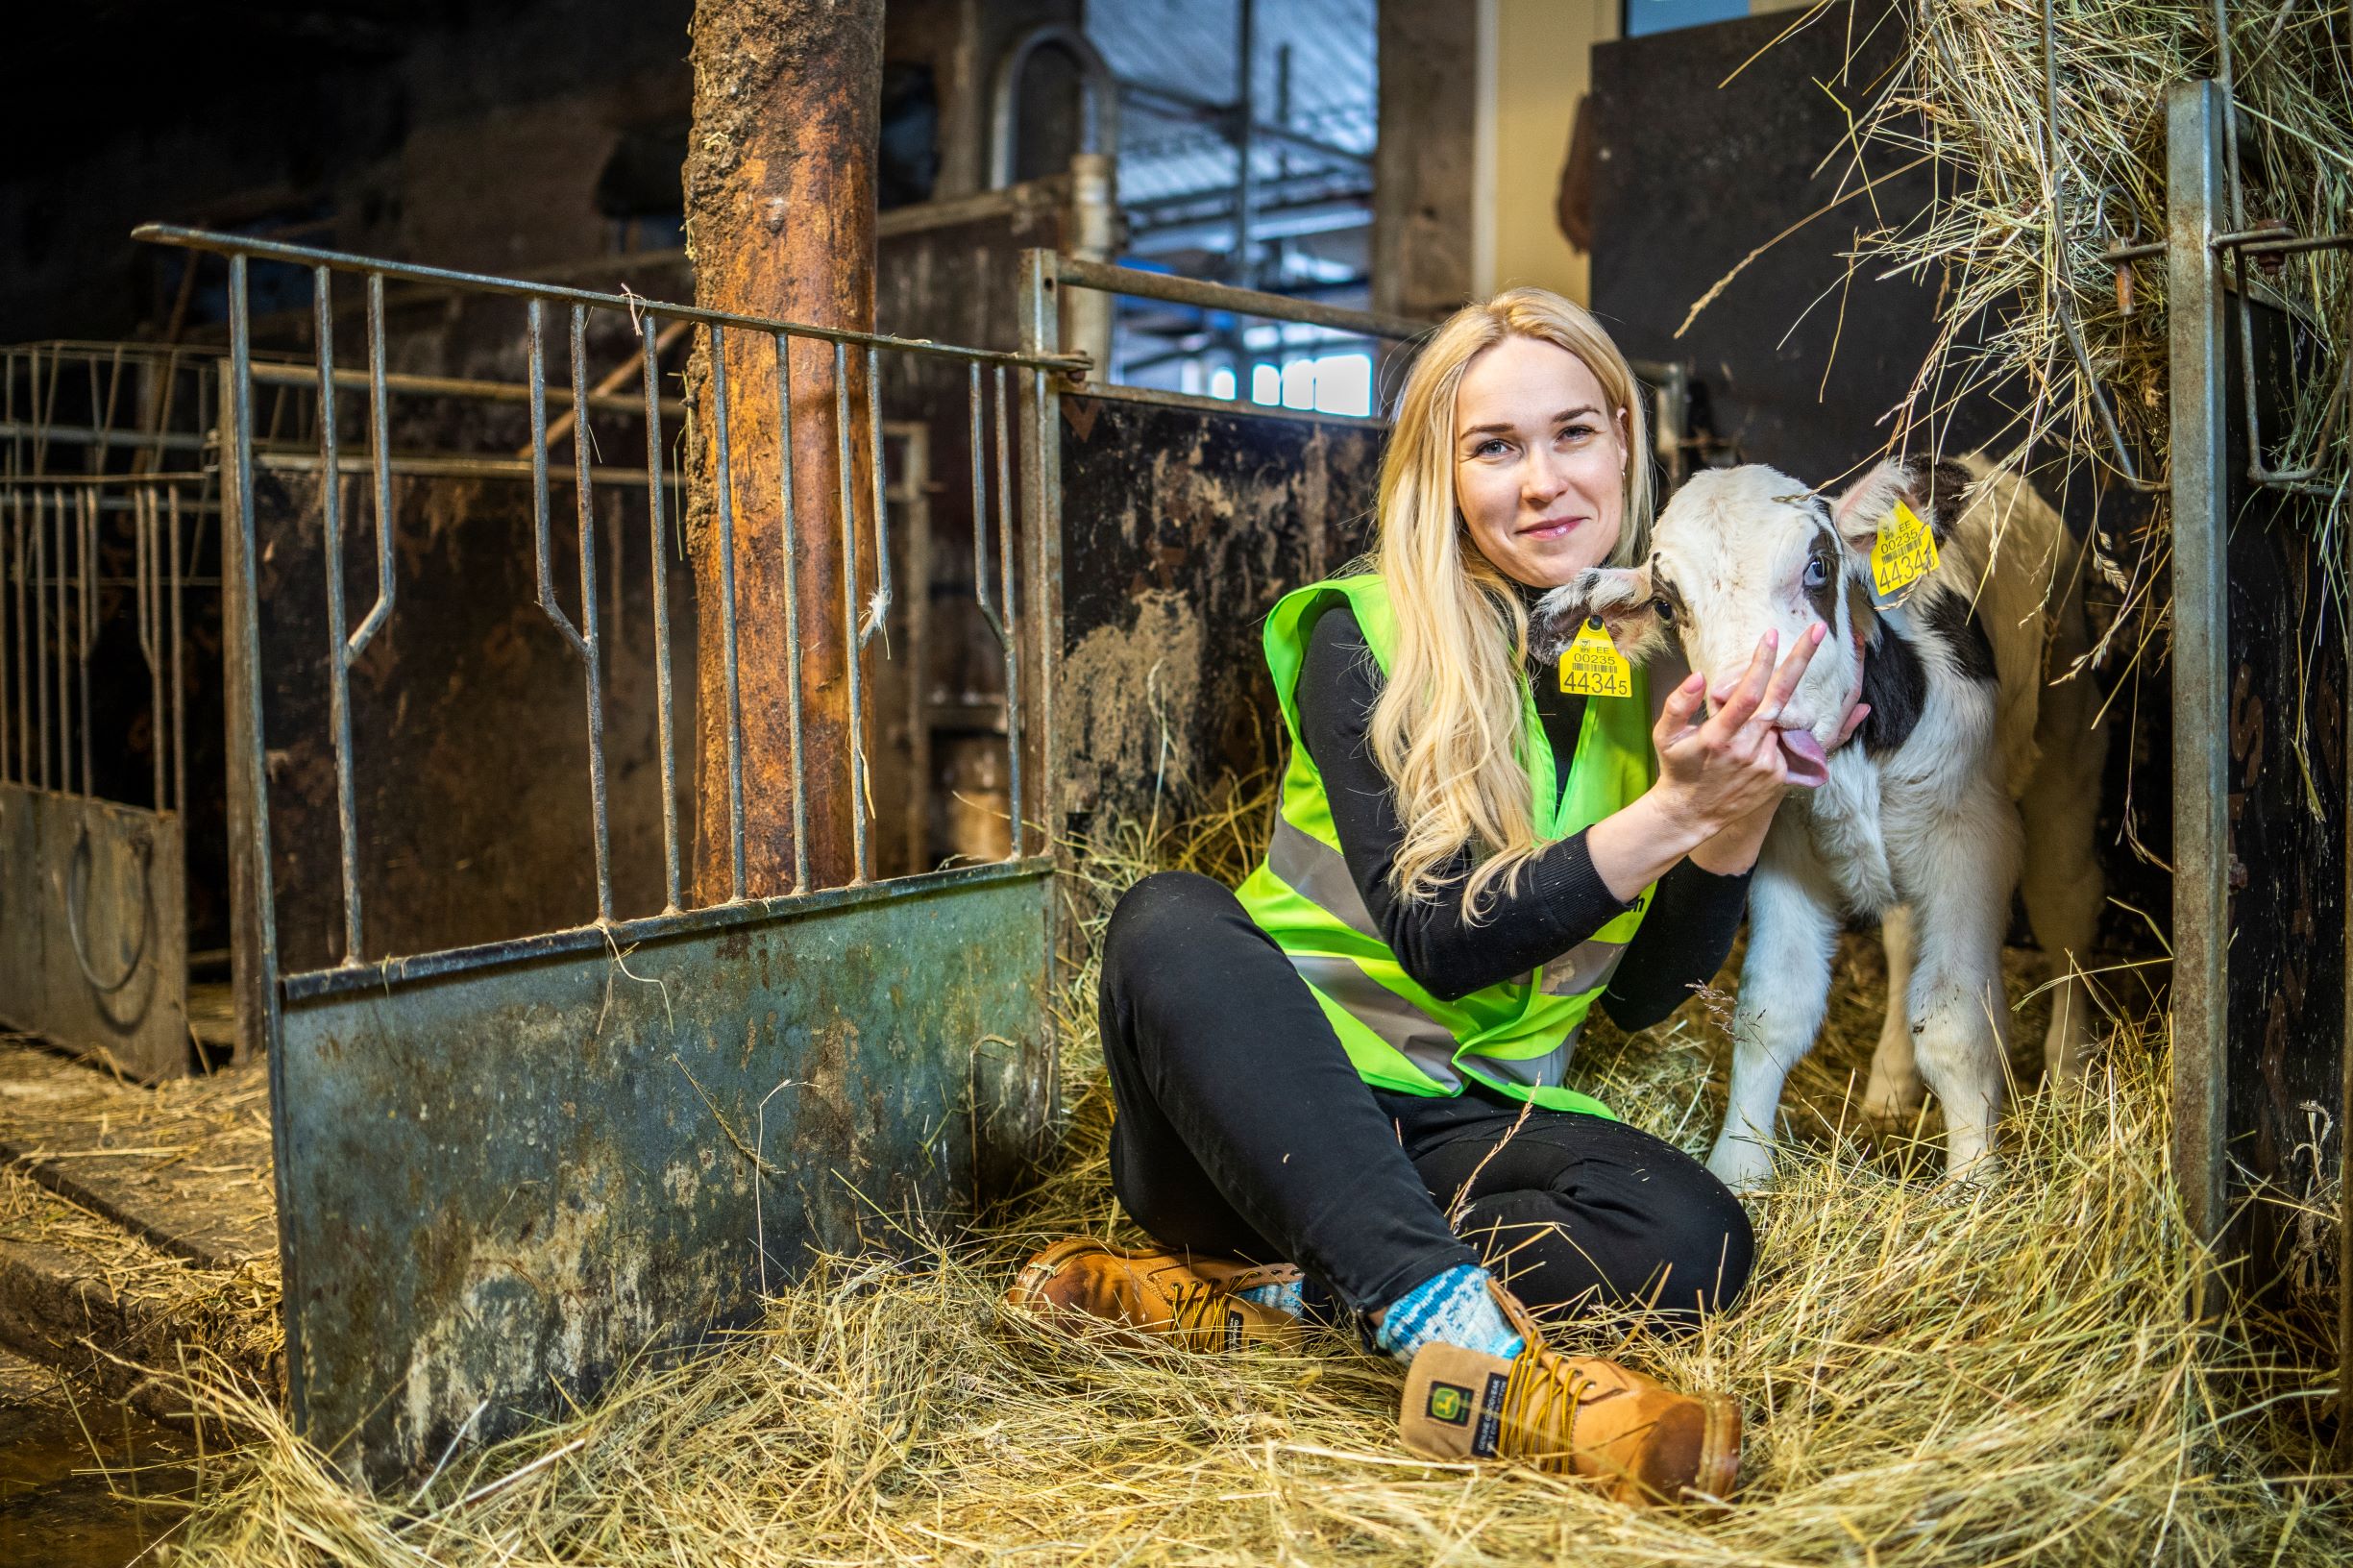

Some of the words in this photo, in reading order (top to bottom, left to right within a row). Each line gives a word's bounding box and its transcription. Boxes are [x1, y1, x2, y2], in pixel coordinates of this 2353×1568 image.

[1899, 520, 1912, 532] EE
[1880, 529, 1918, 553] 00235
[1596, 646, 1609, 654] EE
[1574, 652, 1615, 665] 00235
[1564, 672, 1628, 695] 44345
